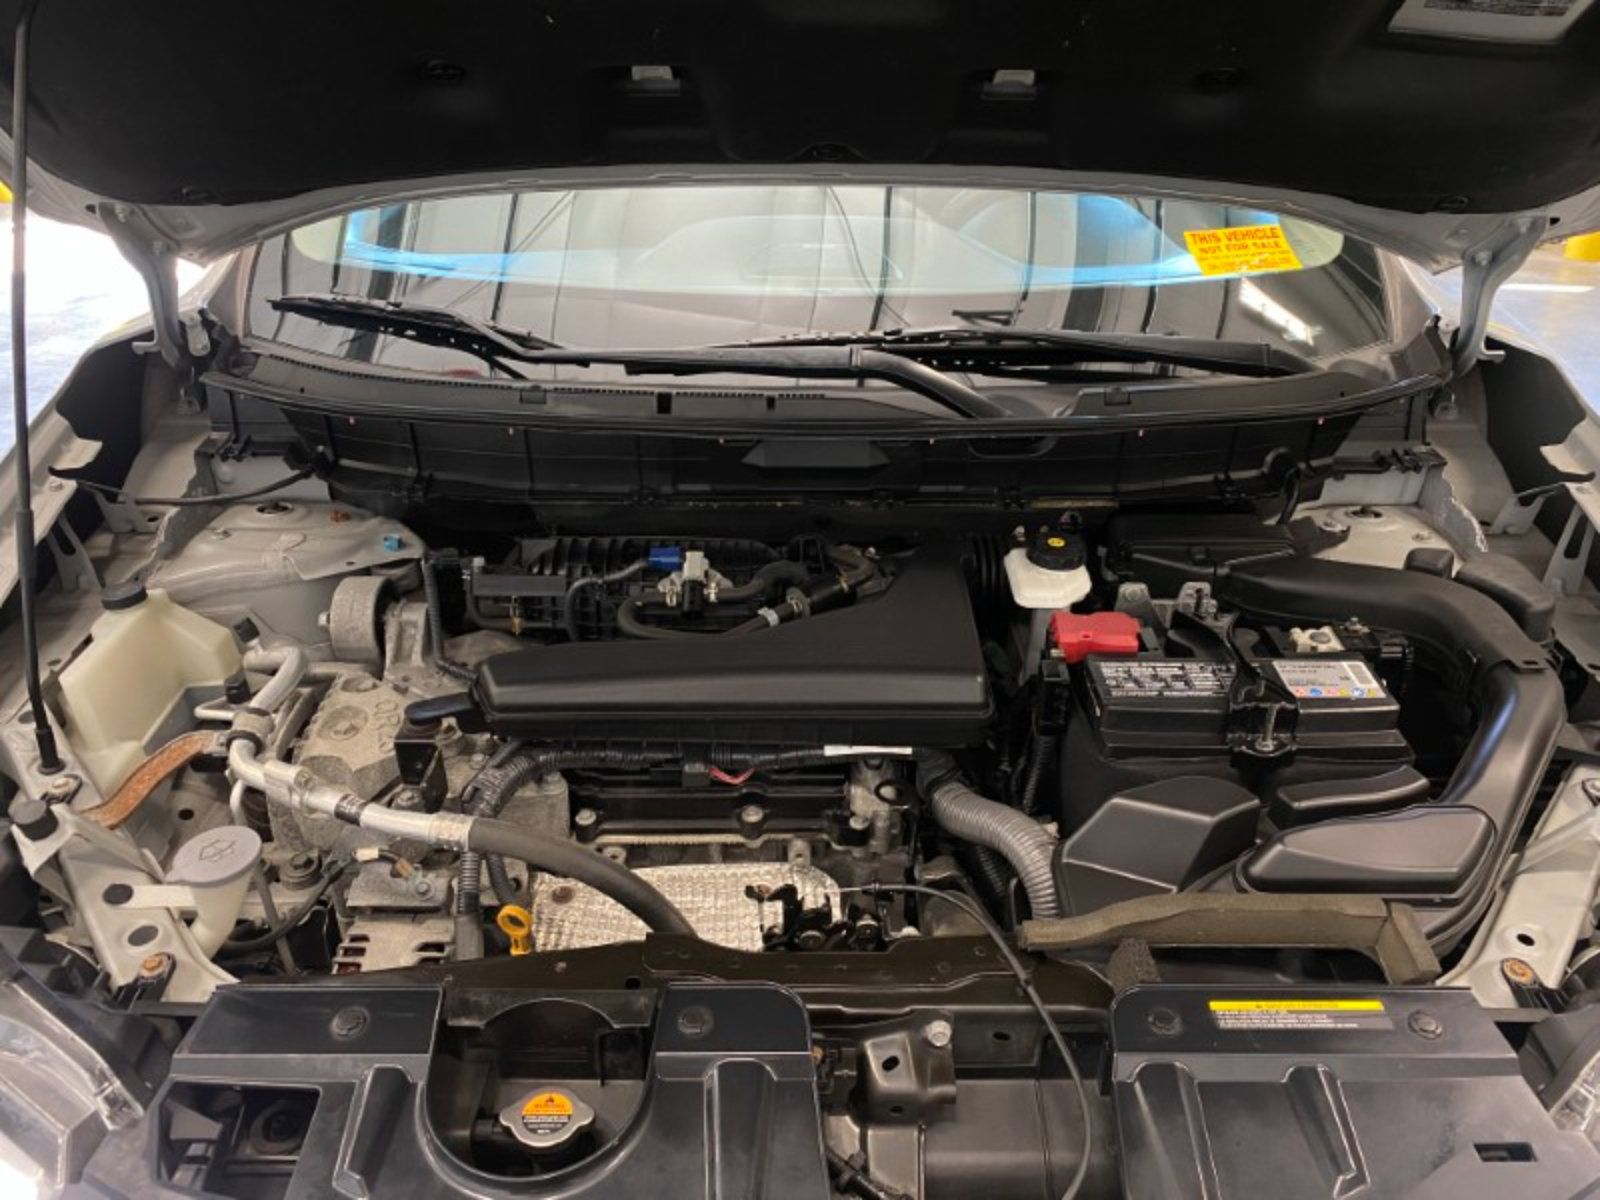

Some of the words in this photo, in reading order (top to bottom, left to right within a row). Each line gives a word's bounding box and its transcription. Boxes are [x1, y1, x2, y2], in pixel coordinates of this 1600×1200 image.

[1189, 231, 1221, 244] THIS
[1223, 227, 1280, 242] VEHICLE
[1199, 245, 1222, 254] NOT
[1225, 242, 1248, 252] FOR
[1252, 241, 1281, 250] SALE
